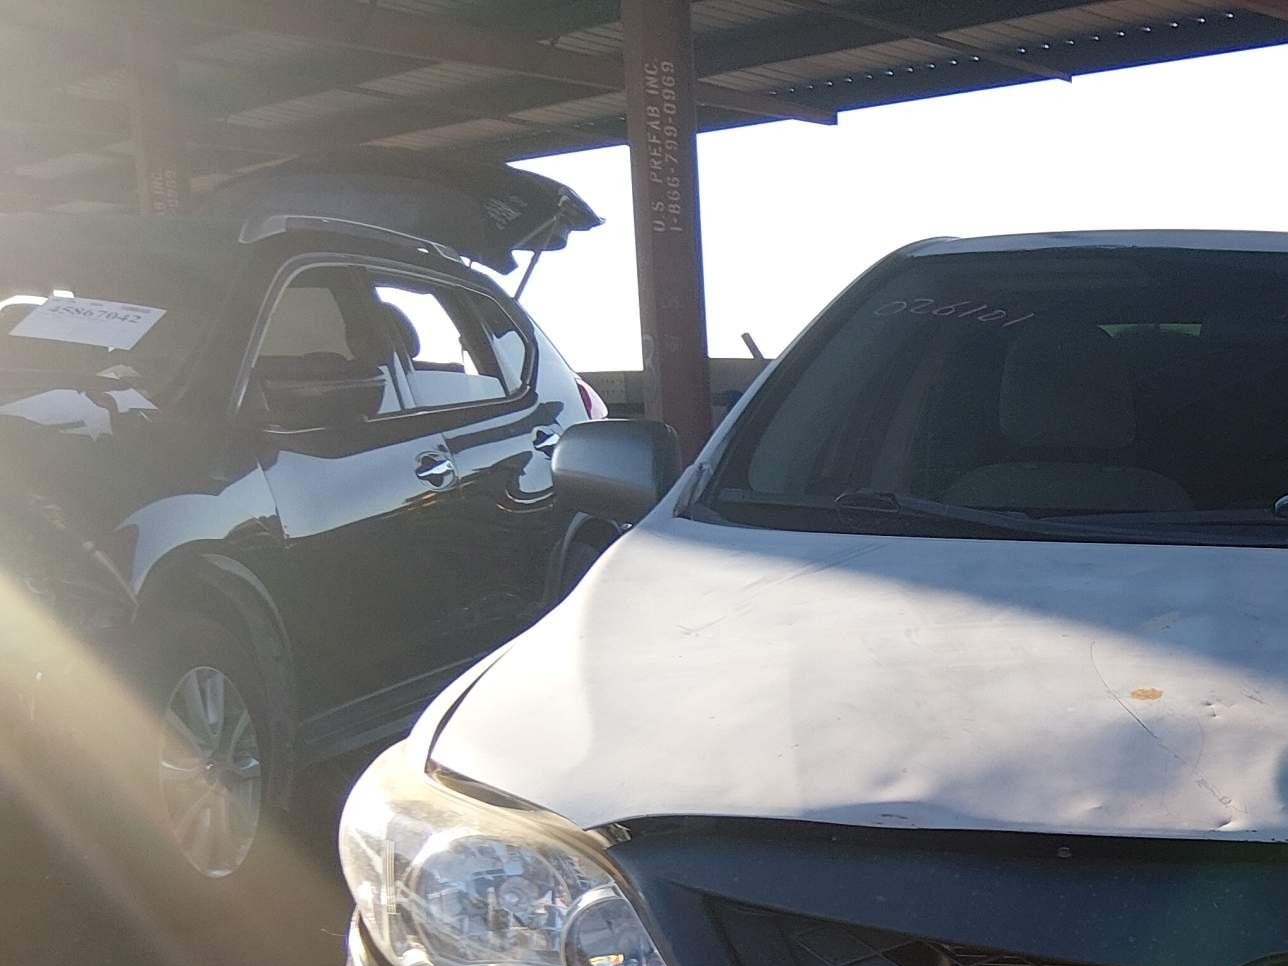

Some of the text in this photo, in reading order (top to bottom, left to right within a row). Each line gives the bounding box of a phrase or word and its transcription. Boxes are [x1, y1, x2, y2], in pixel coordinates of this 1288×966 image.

[647, 105, 663, 183] PREFAB
[661, 61, 682, 231] 1-866-799-0969
[48, 305, 142, 323] 45867042
